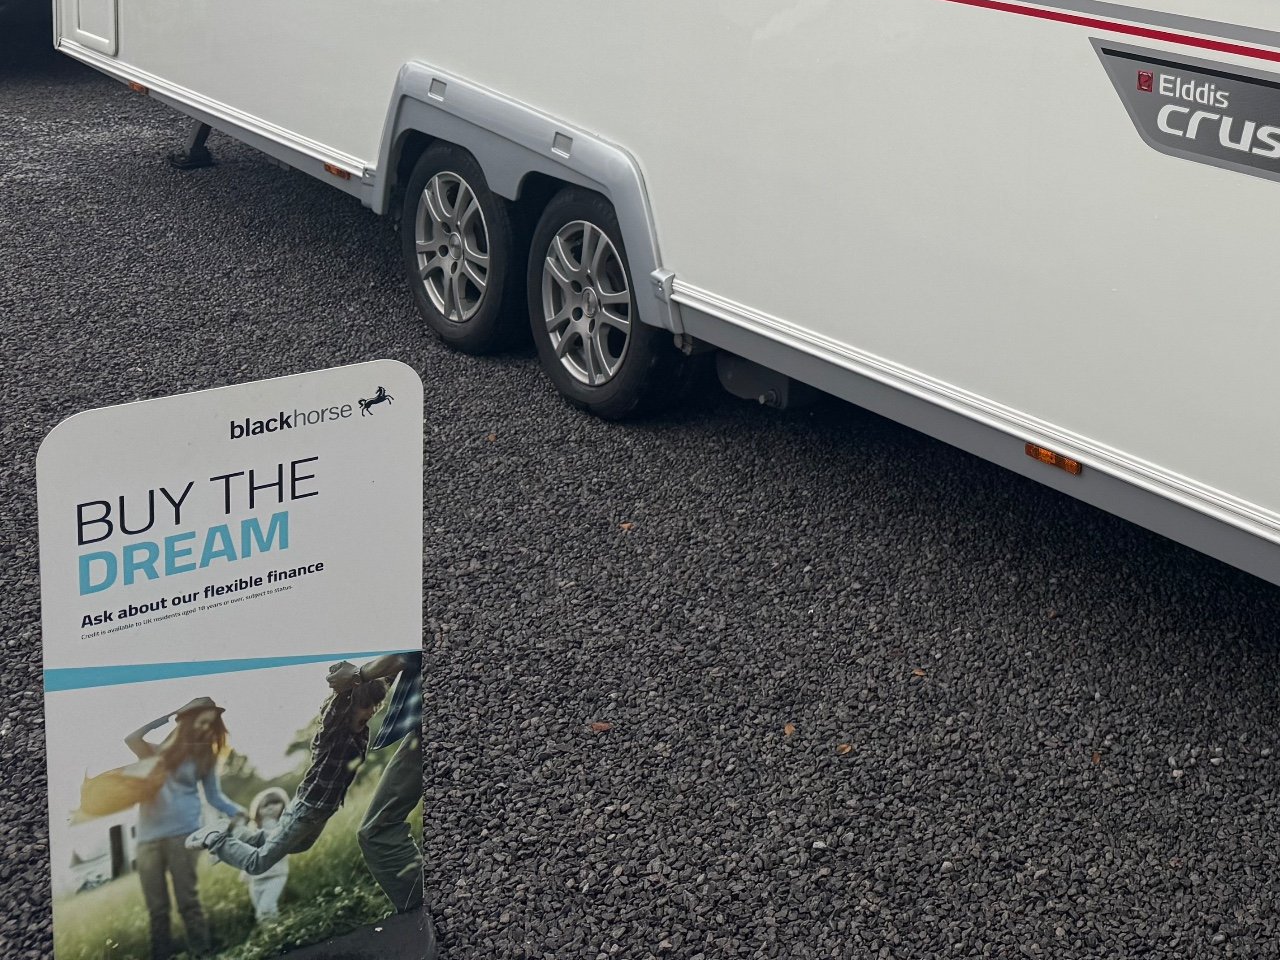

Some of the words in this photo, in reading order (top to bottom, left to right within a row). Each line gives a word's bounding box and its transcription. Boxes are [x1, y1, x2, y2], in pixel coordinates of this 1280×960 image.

[1159, 74, 1230, 108] Elddis
[229, 401, 353, 440] blackhorse
[76, 480, 195, 546] BUY
[209, 455, 319, 515] THE
[78, 510, 290, 597] DREAM
[81, 610, 113, 628] Ask
[117, 597, 167, 619] about
[171, 591, 200, 606] our
[203, 576, 263, 599] flexible
[266, 559, 325, 583] finance
[81, 632, 100, 640] Credit
[107, 623, 134, 634] available
[207, 601, 223, 610] years
[245, 591, 266, 600] subject
